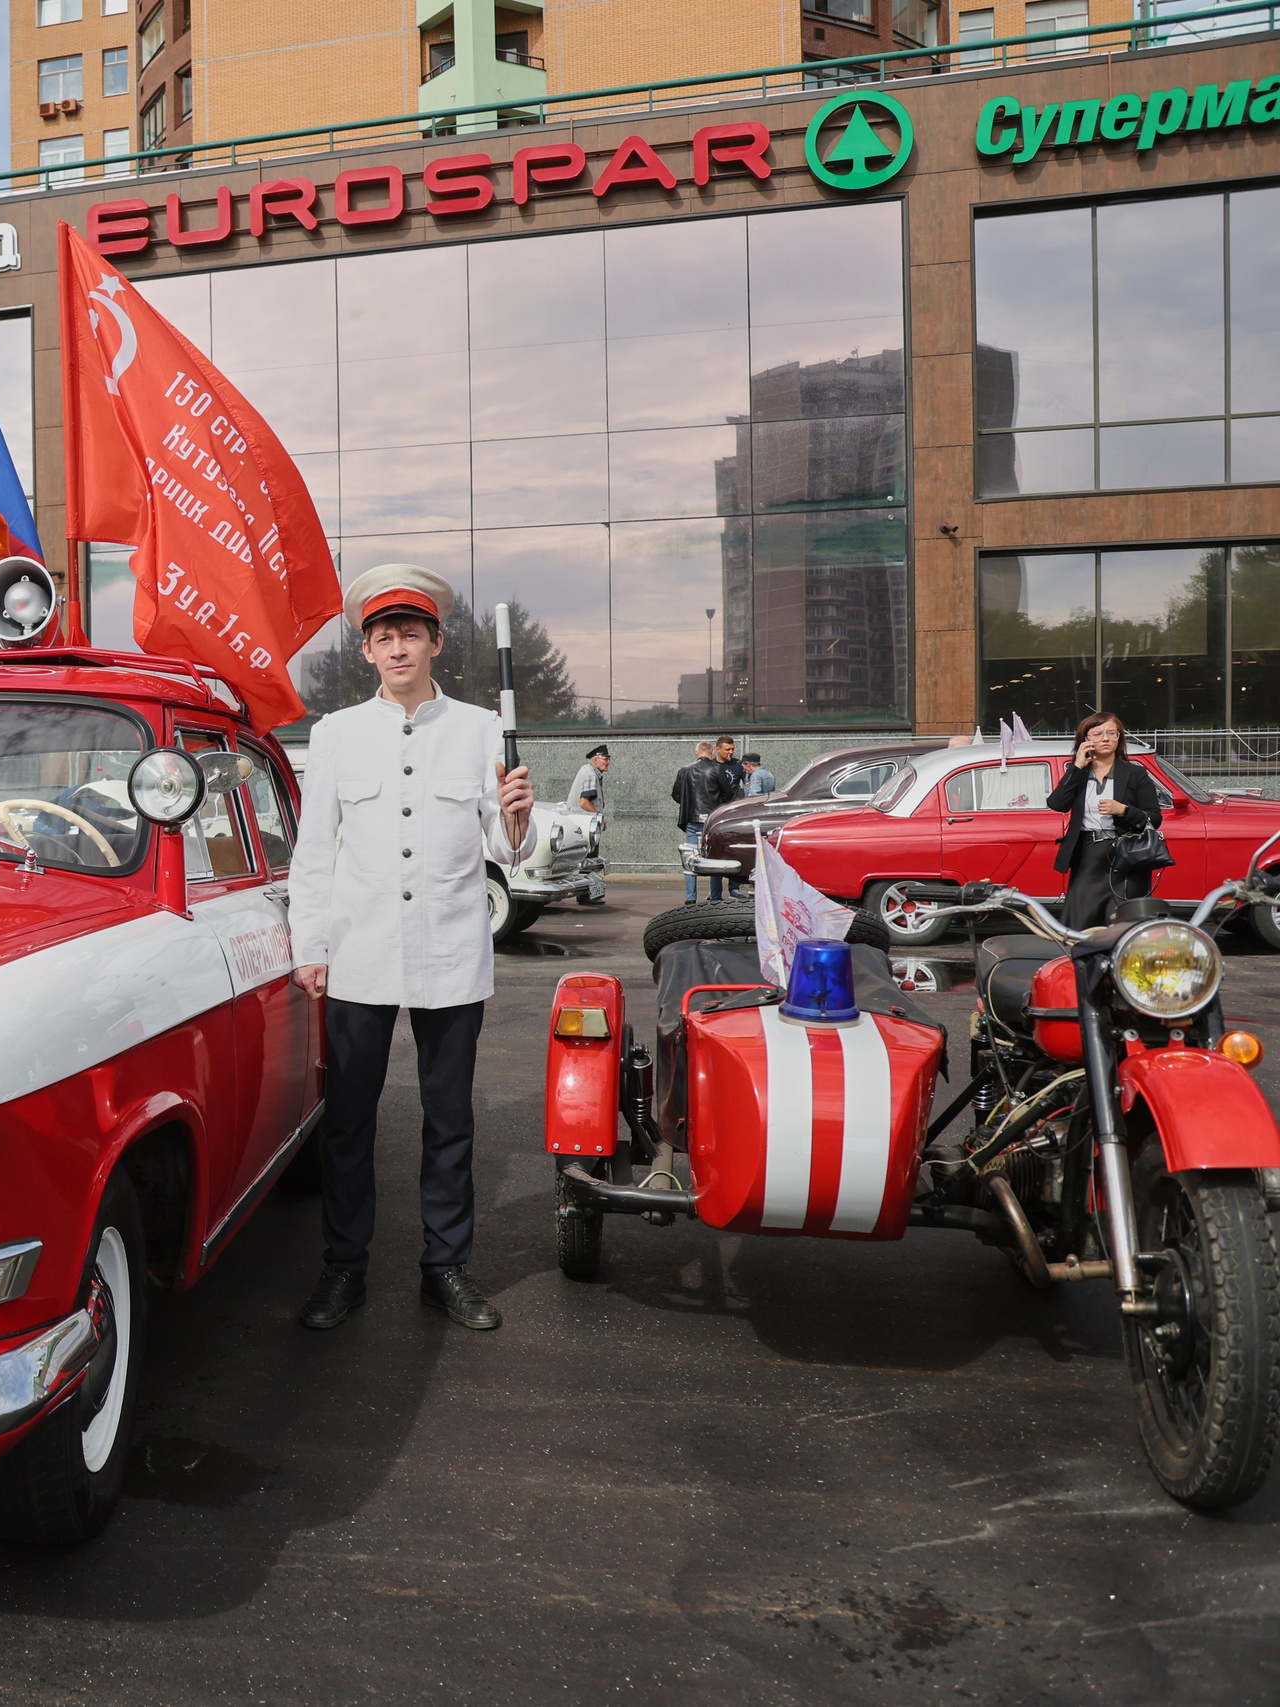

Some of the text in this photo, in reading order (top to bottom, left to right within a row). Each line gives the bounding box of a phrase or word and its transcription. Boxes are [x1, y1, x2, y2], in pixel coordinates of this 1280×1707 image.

[975, 74, 1280, 165] Суперма
[86, 121, 772, 255] EUROSPAR
[165, 371, 247, 465] 150 СТР.
[157, 561, 186, 596] 3
